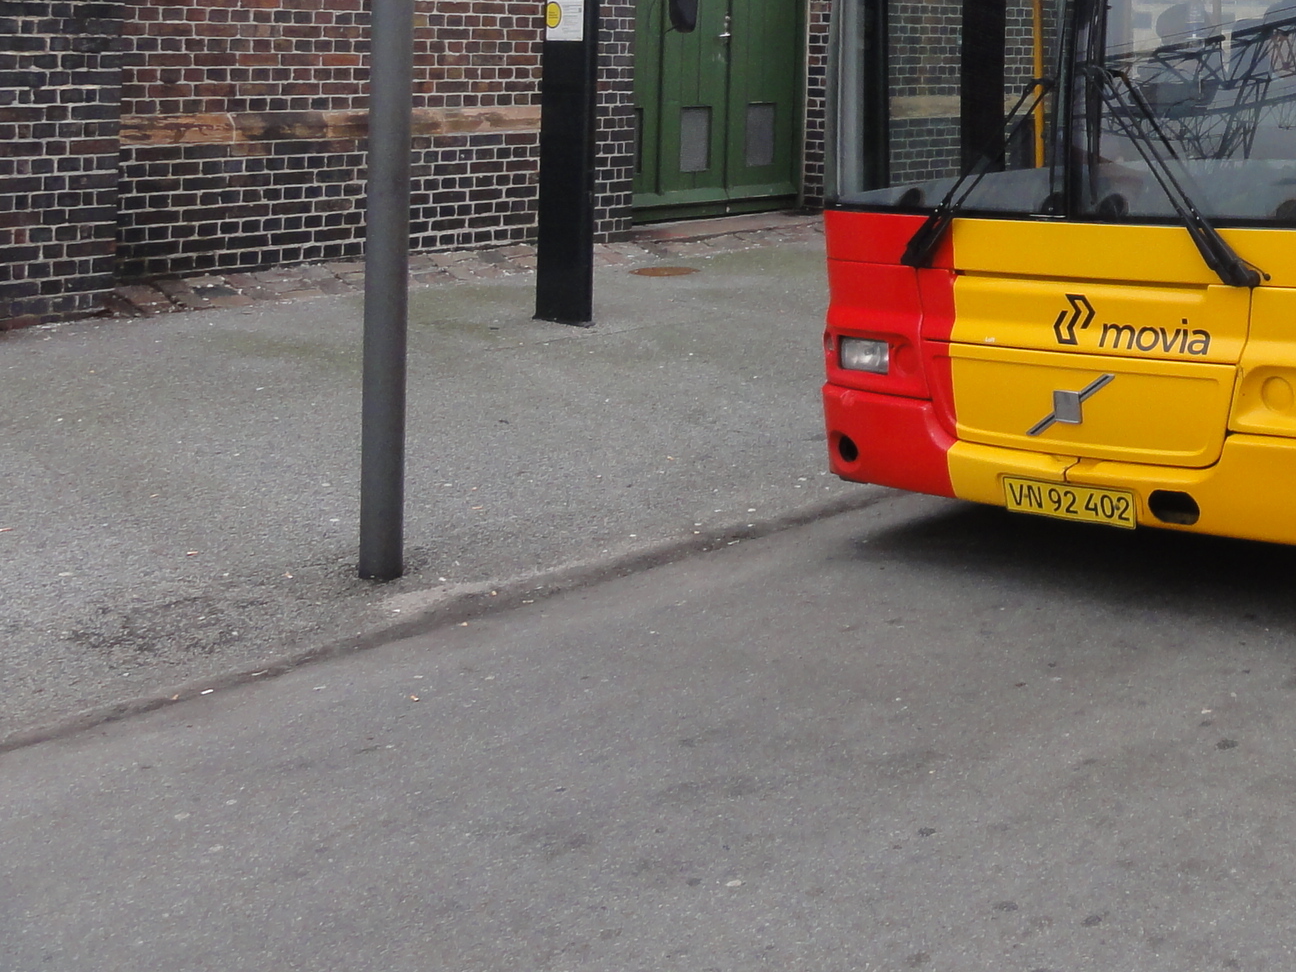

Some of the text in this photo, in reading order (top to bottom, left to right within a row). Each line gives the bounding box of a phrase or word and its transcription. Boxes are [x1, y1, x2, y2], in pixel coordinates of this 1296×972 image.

[1098, 318, 1211, 356] movia
[1008, 481, 1131, 521] VN 92 402
